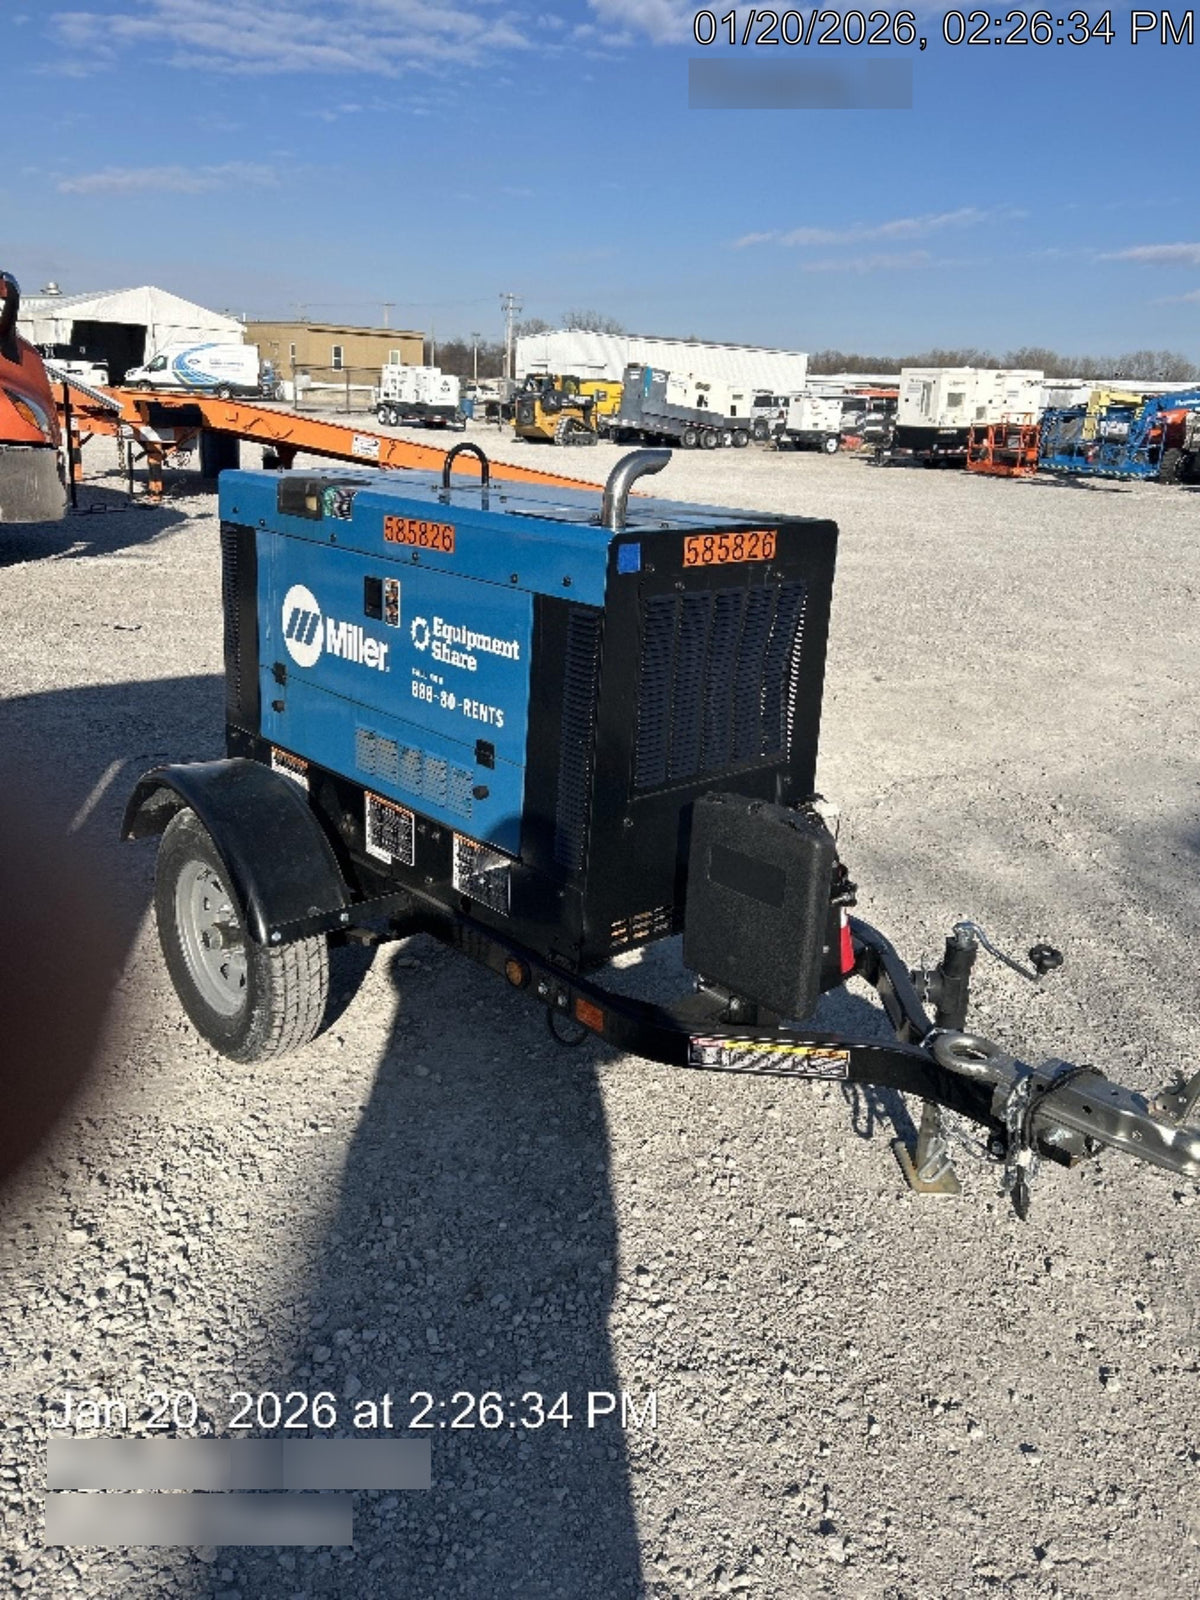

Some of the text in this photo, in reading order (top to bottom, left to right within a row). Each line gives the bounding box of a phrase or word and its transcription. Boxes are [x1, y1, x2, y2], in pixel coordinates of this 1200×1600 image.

[384, 516, 454, 553] 585826
[686, 532, 774, 565] 585826
[326, 616, 389, 672] Miller
[431, 640, 478, 672] Share
[432, 616, 520, 660] Equipment
